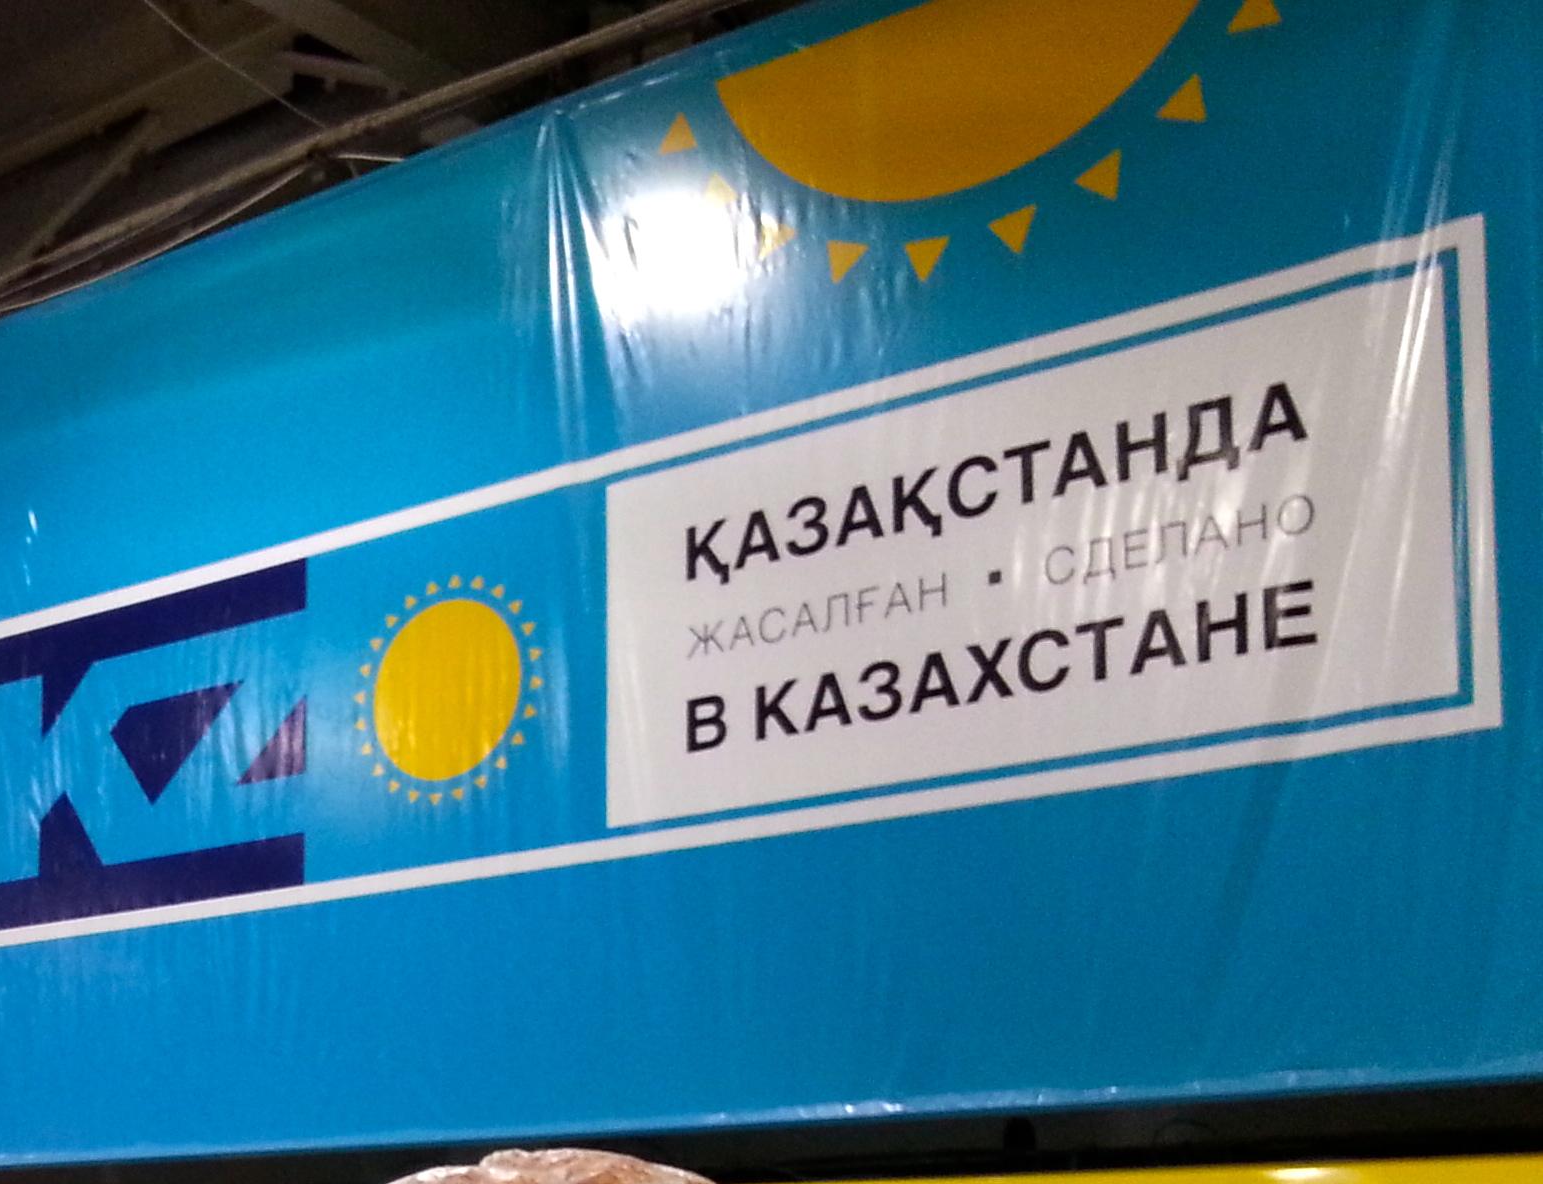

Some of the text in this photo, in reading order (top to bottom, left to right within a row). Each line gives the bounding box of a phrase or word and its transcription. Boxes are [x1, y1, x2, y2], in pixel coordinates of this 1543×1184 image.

[686, 381, 1309, 586] ҚАЗАҚСТАНДА
[686, 494, 1315, 659] ЖАСАЛҒАН СДЕЛАНО
[686, 580, 1318, 753] В КАЗАХСТАНЕ
